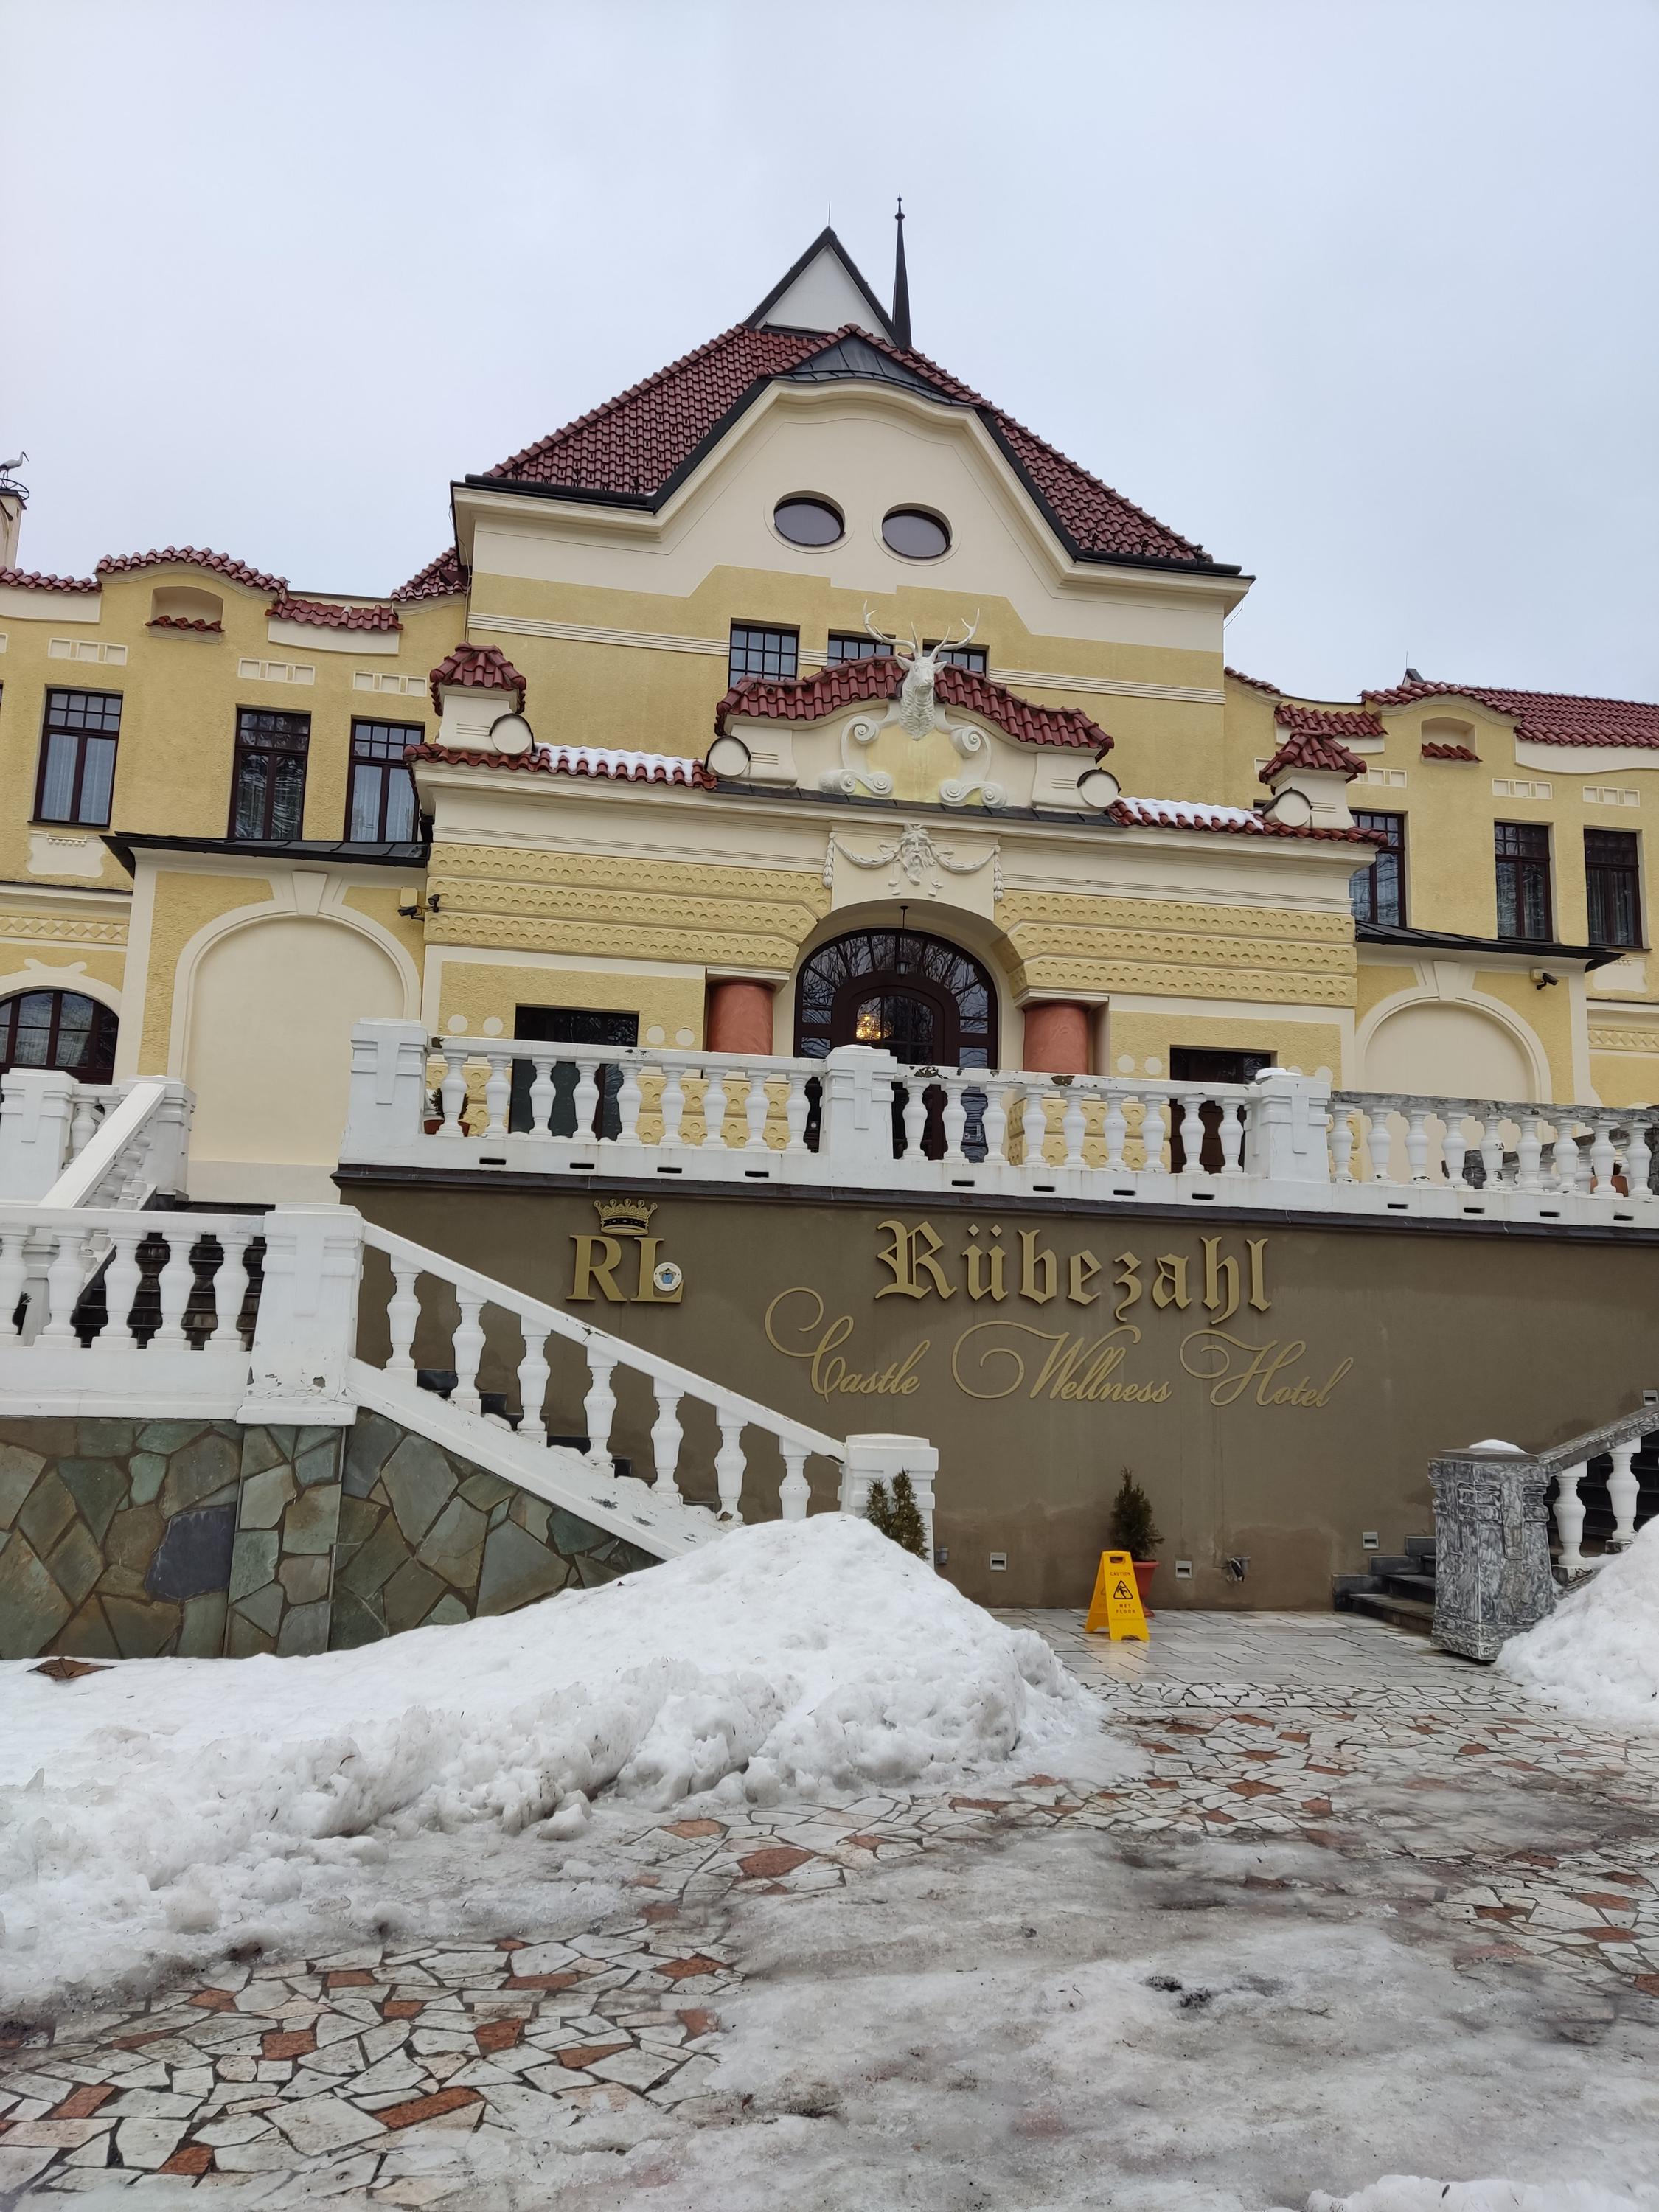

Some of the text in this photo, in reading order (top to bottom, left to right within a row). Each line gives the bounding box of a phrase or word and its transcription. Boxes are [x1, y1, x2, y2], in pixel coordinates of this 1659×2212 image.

[566, 1234, 684, 1304] RL
[874, 1220, 1273, 1325] Rübezahl
[765, 1287, 1354, 1408] Castle Wellness Hotel
